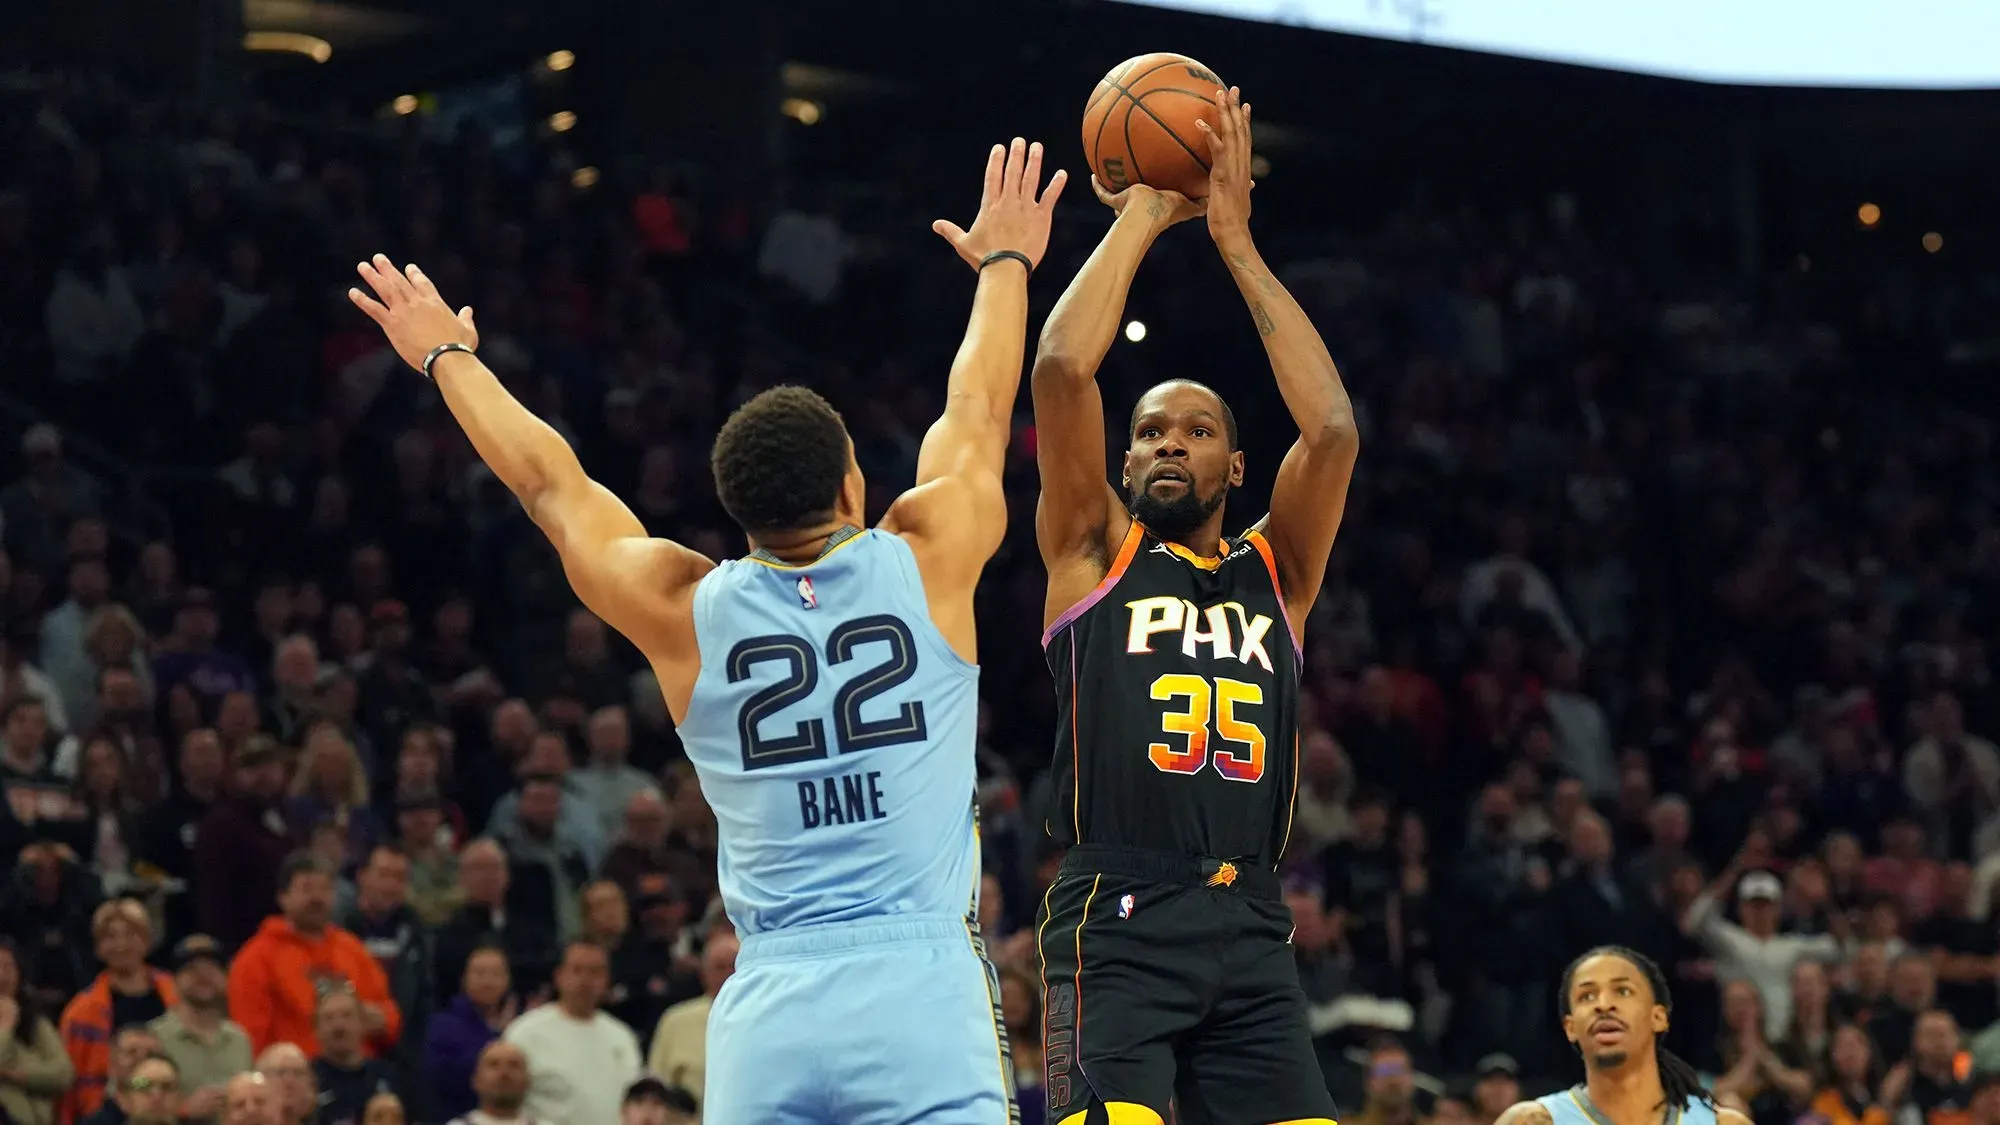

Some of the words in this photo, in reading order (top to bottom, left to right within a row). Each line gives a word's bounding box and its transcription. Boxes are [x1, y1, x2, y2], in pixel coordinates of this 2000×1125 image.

[1124, 596, 1274, 674] PHX
[726, 613, 927, 771] 22
[1148, 673, 1266, 783] 35
[797, 771, 887, 829] BANE
